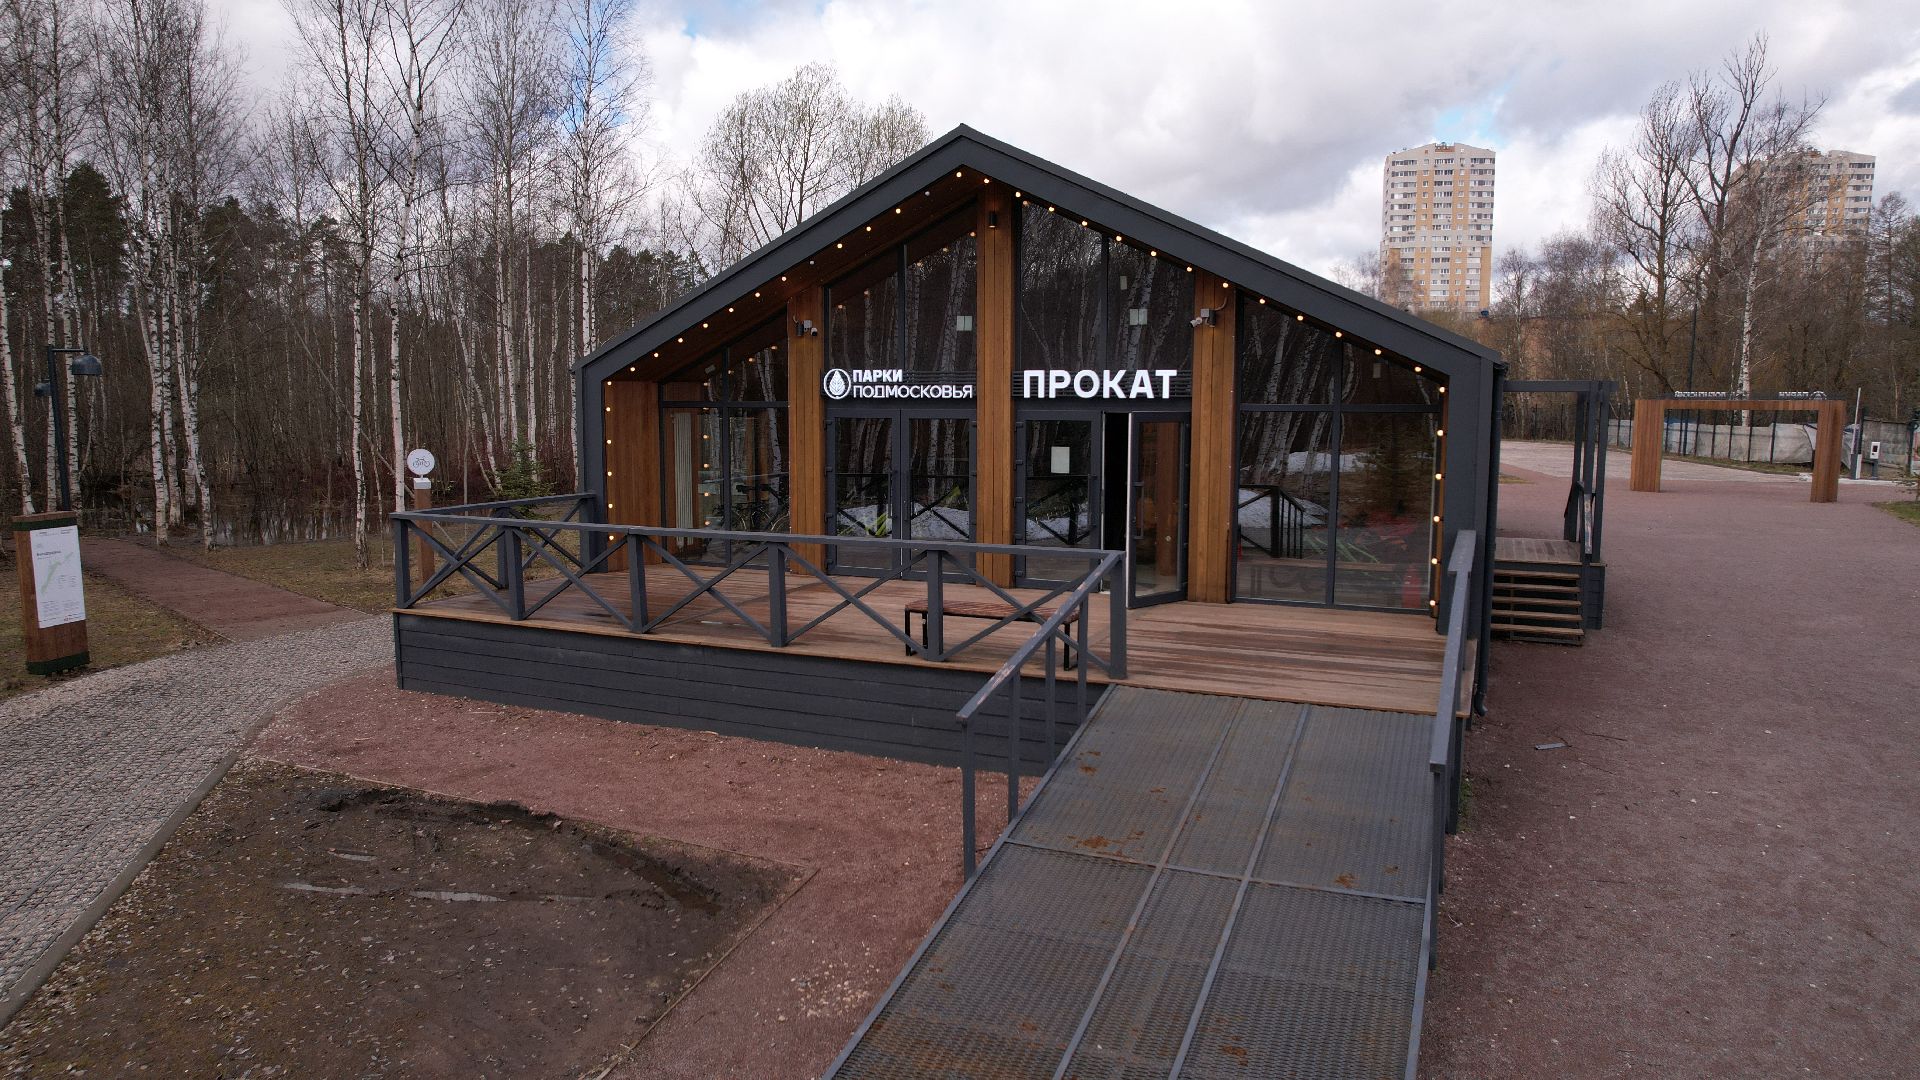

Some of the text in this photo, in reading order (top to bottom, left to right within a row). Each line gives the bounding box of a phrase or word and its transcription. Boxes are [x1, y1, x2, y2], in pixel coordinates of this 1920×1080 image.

[853, 369, 903, 383] ПАРКИ
[1024, 370, 1178, 399] ПРОКАТ
[853, 385, 973, 399] ПОДМОСКОВЬЯ
